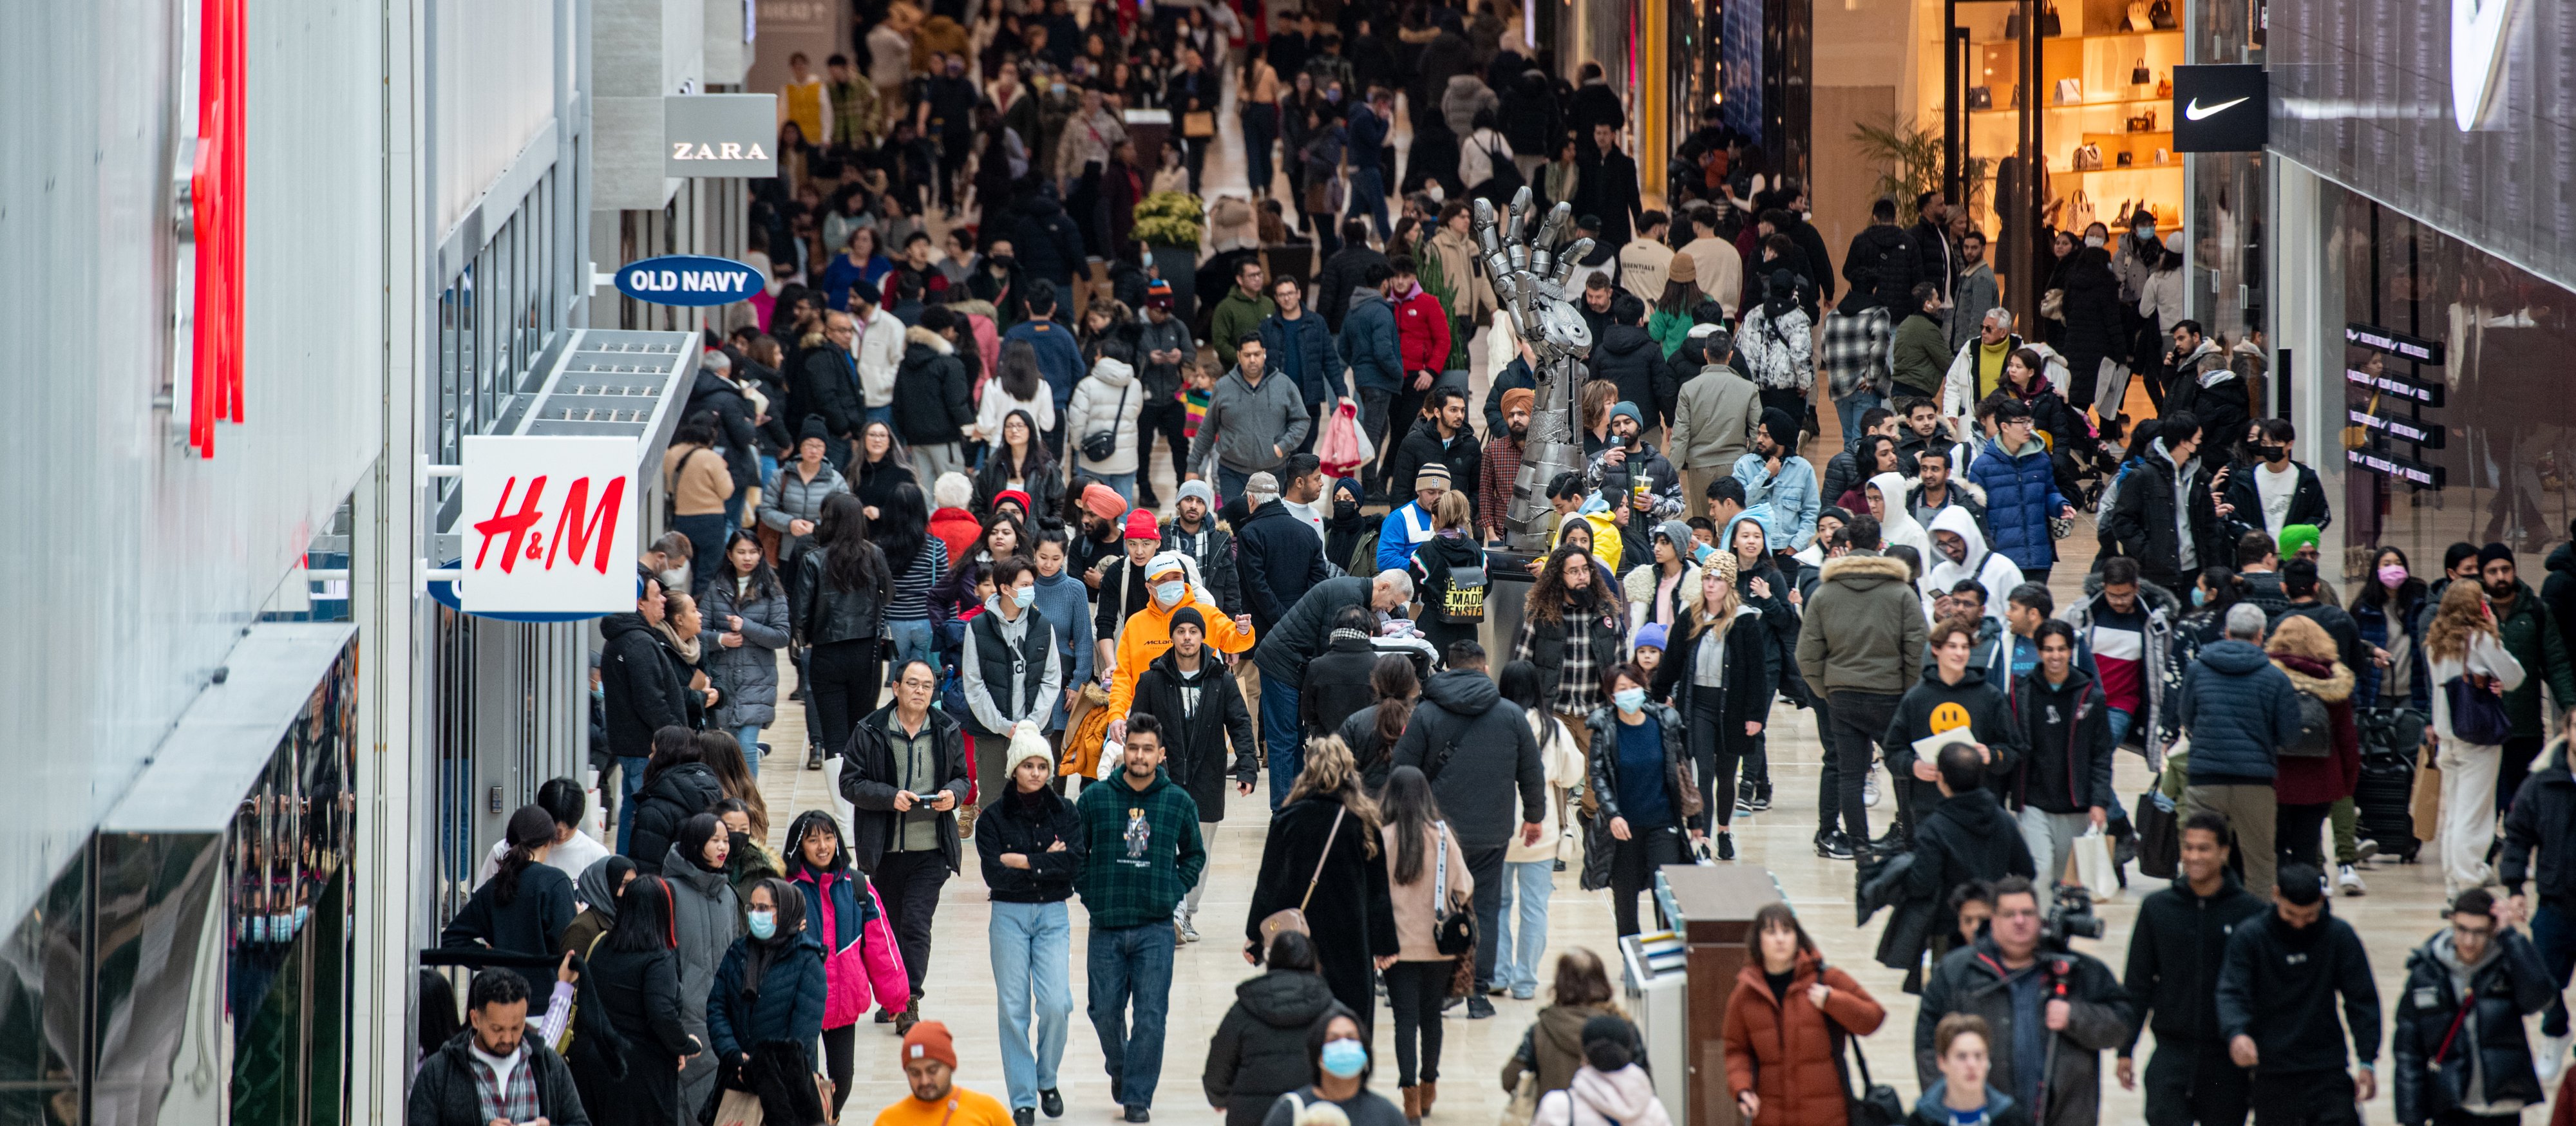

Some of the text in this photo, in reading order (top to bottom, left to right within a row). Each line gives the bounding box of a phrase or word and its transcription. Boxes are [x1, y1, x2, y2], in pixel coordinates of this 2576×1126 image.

[673, 142, 769, 160] ZARA
[630, 270, 749, 292] OLD NAVY
[473, 475, 626, 575] H&M
